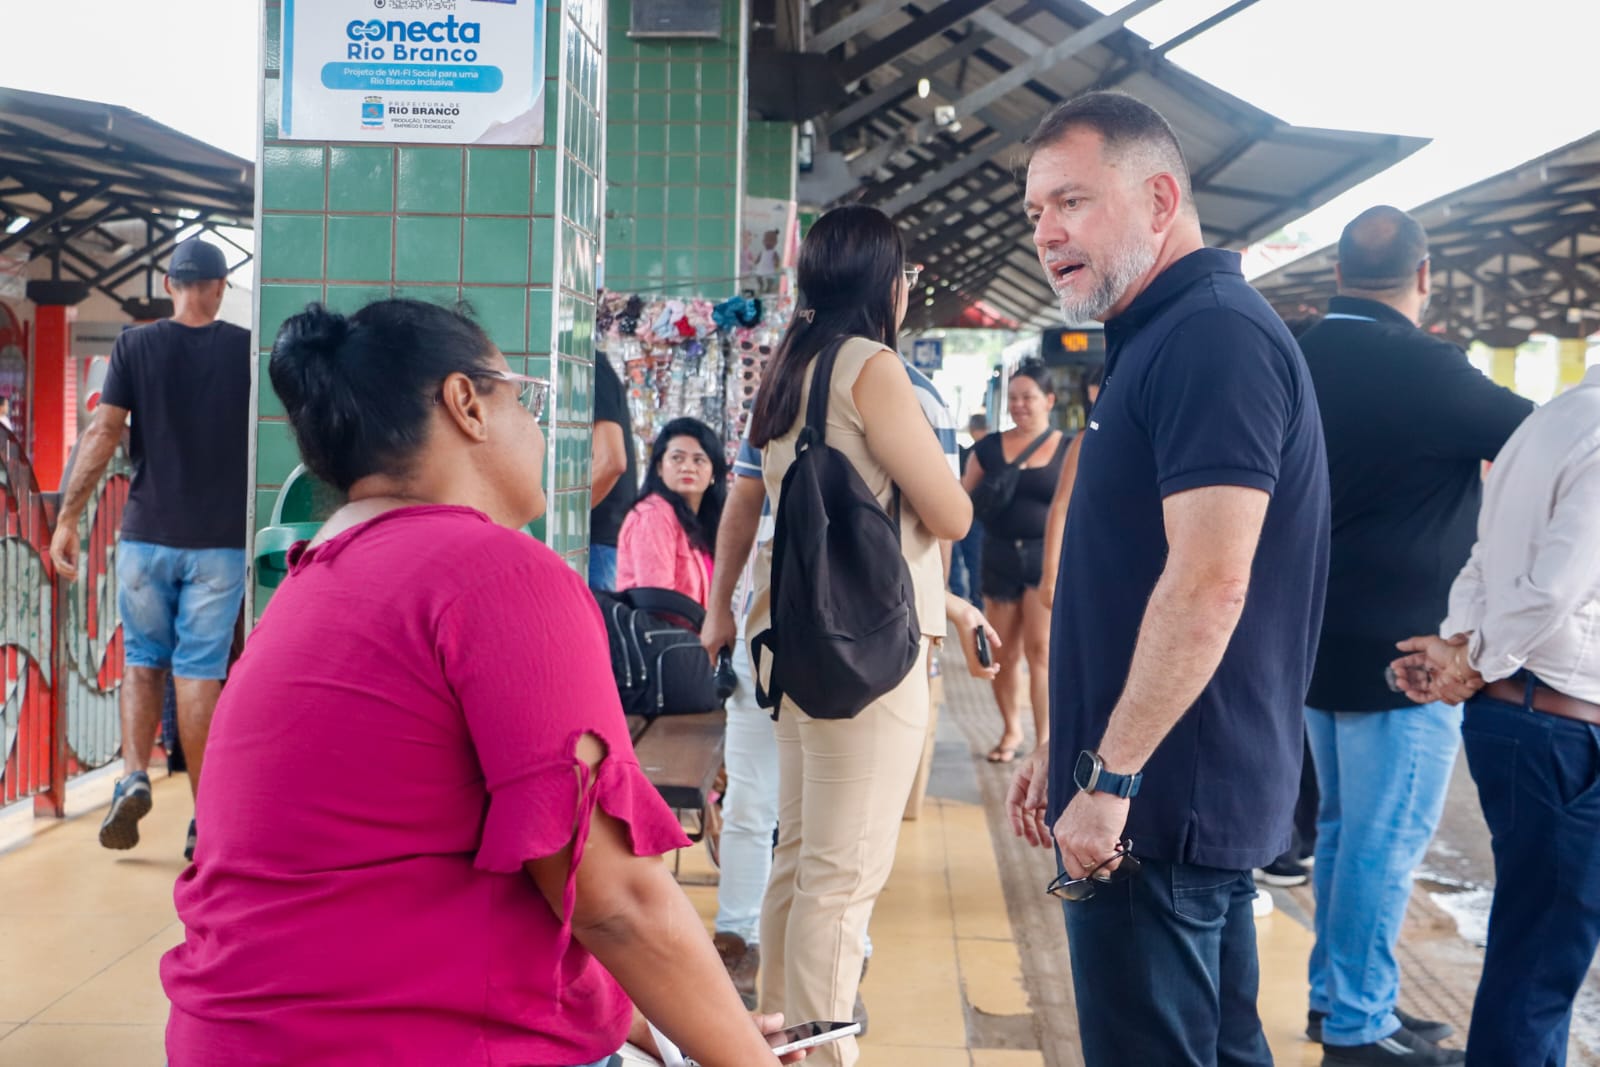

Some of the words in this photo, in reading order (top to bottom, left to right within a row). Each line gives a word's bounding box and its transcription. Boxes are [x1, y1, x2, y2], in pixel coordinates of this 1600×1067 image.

[346, 14, 480, 43] conecta
[347, 42, 385, 60] Rio
[393, 44, 477, 62] Branco
[343, 67, 375, 78] Projeto
[375, 68, 387, 76] de
[412, 69, 437, 78] Social
[438, 71, 457, 79] para
[459, 71, 479, 79] uma
[370, 77, 385, 85] Rio
[386, 77, 416, 86] Branco
[388, 106, 409, 115] RIO
[412, 107, 460, 116] BRANCO
